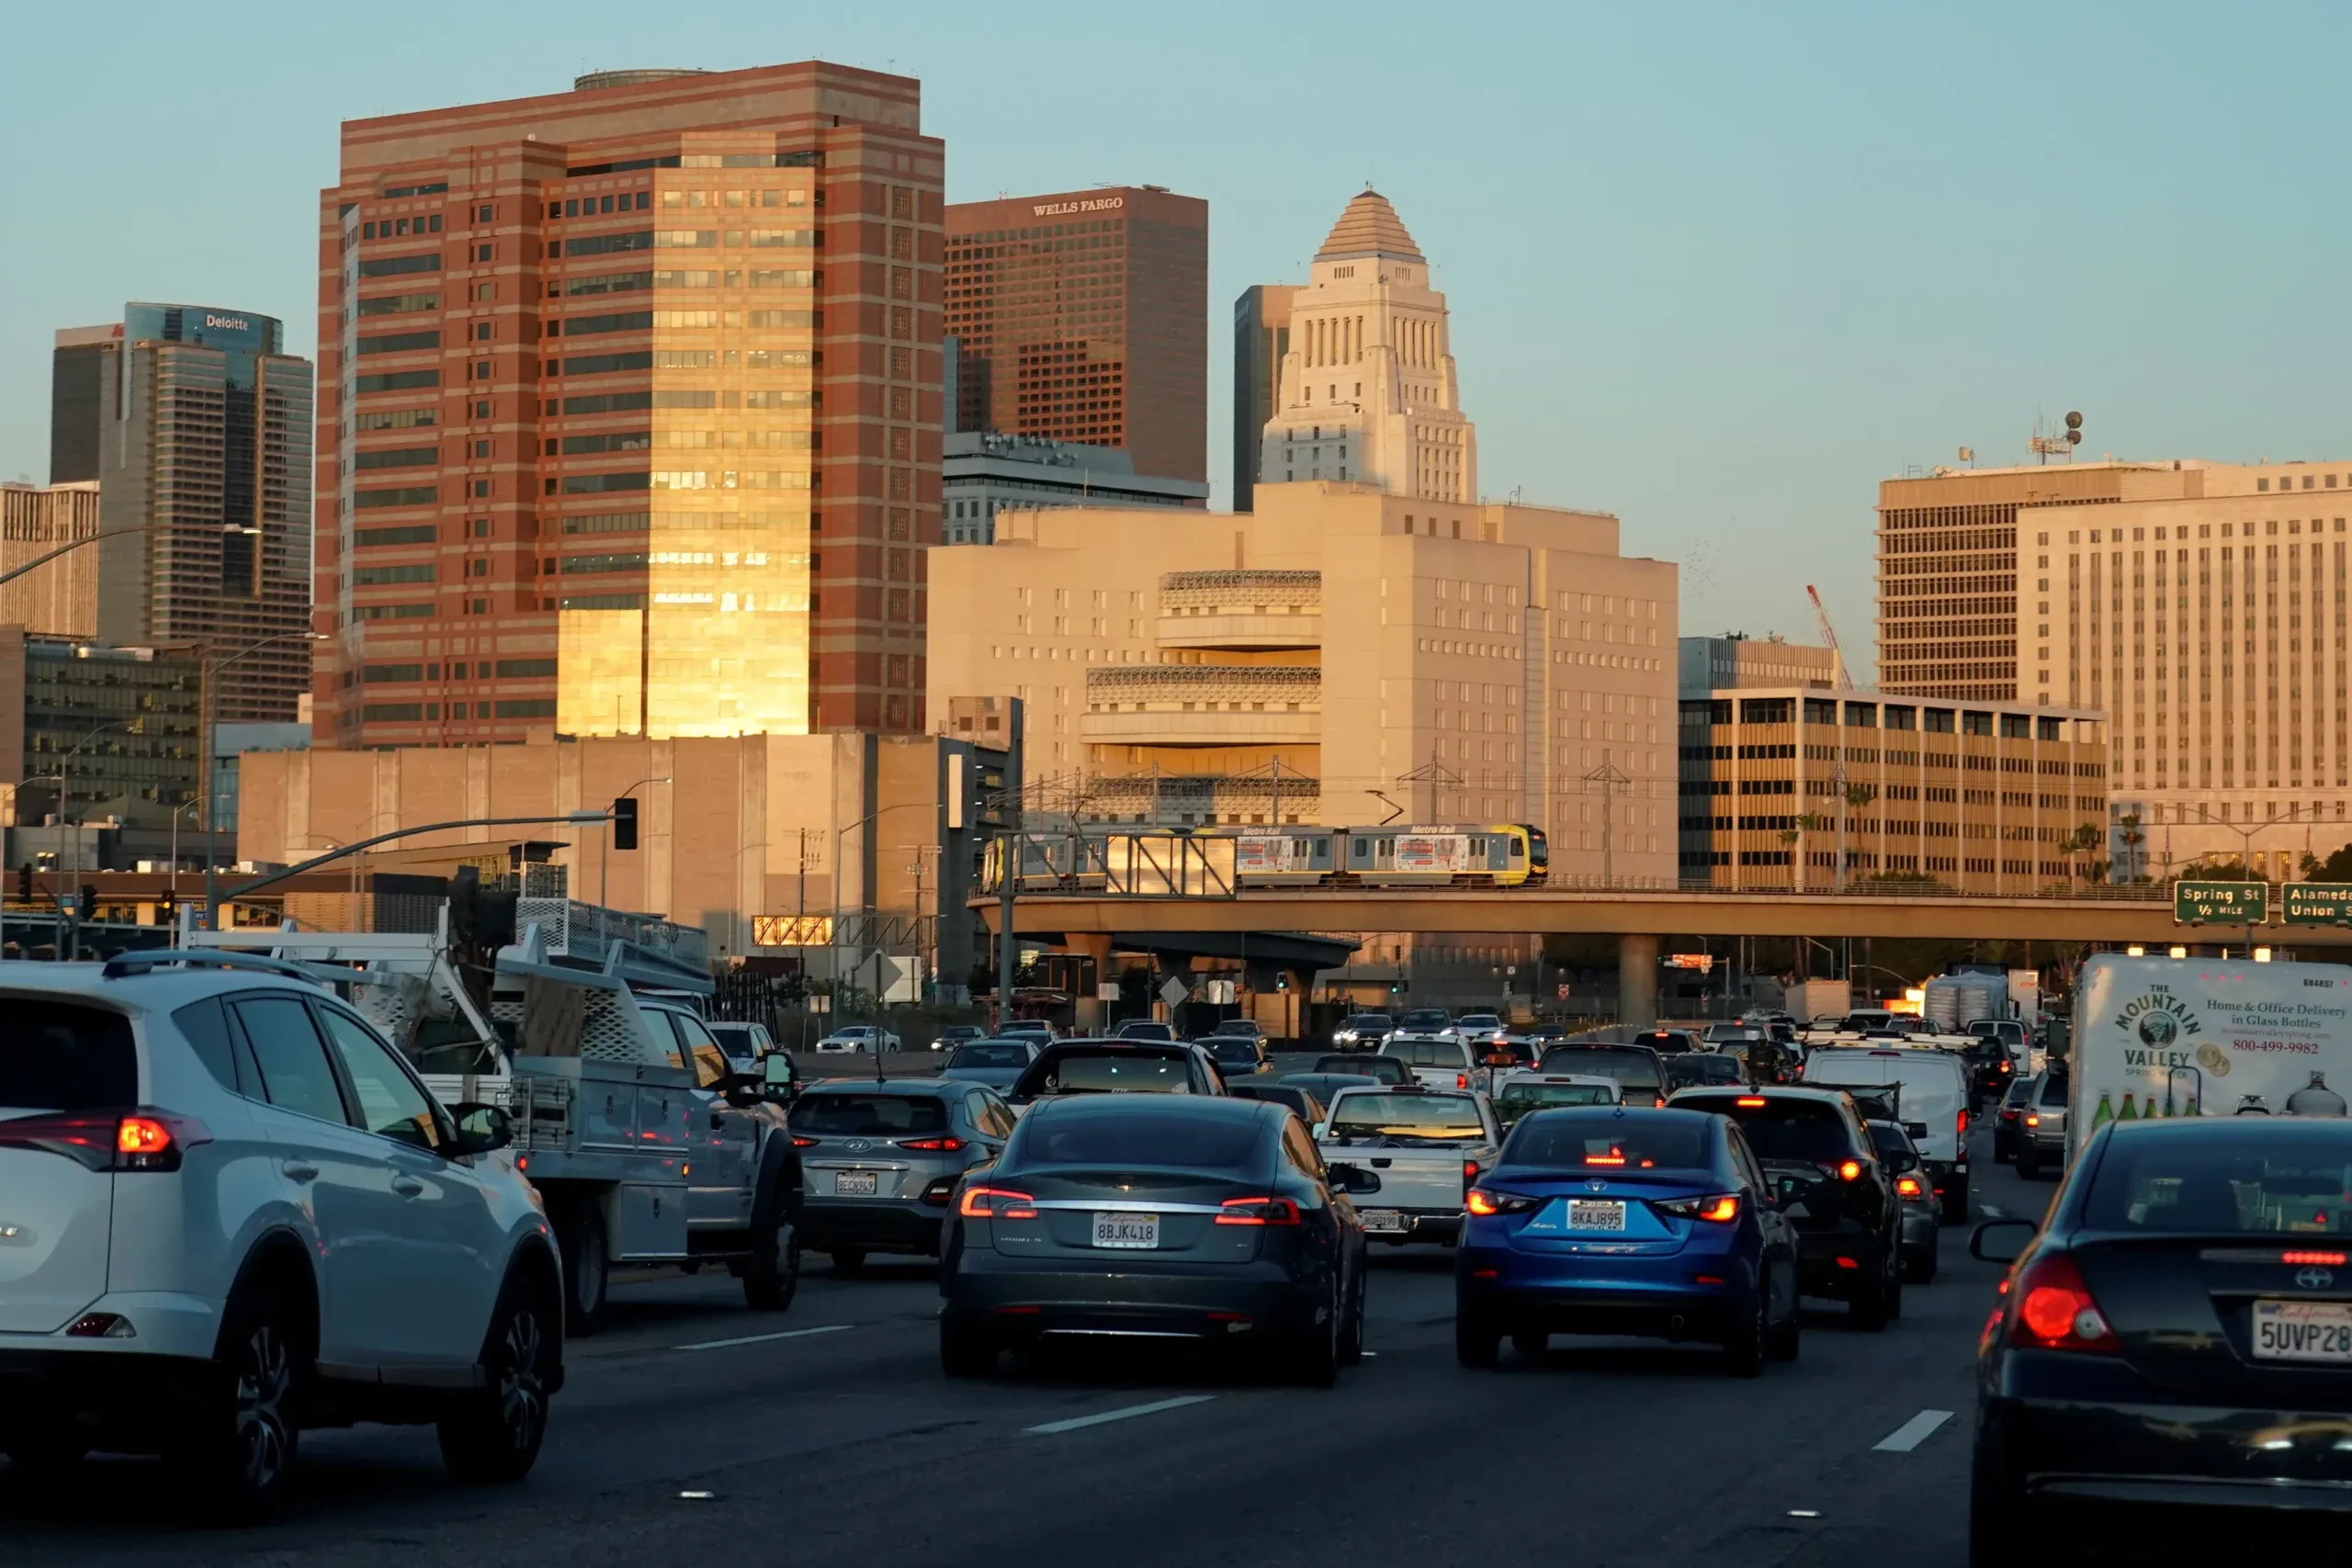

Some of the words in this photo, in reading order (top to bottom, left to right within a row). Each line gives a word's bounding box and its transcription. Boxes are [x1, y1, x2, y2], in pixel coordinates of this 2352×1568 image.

[1034, 202, 1078, 216] WELLS
[1080, 197, 1123, 211] FARGO
[1242, 827, 1266, 835] Metro
[1267, 827, 1282, 835] Rail
[1411, 826, 1438, 834] Metro
[1439, 825, 1456, 833] Rail
[2184, 888, 2233, 904] Spring
[2244, 890, 2260, 901] St
[2290, 888, 2352, 900] Alameda
[2219, 907, 2244, 915] MILE
[2290, 905, 2335, 917] Union
[2150, 984, 2169, 993] THE
[2115, 994, 2202, 1035] MOUNTAIN
[2207, 999, 2242, 1011] Home
[2245, 1002, 2257, 1011] &
[2257, 1002, 2295, 1014] Office
[2297, 1004, 2348, 1020] Delivery
[2232, 1014, 2244, 1024] in
[2246, 1015, 2279, 1027] Glass
[2281, 1017, 2323, 1029] Bottles
[2233, 1039, 2319, 1055] 800-499-9982
[2124, 1050, 2190, 1068] VALLEY
[2160, 1069, 2188, 1079] WER
[1571, 1213, 1622, 1226] 8KAJ895
[1098, 1224, 1154, 1240] 8BJK418
[2261, 1322, 2352, 1352] 5UVP28
